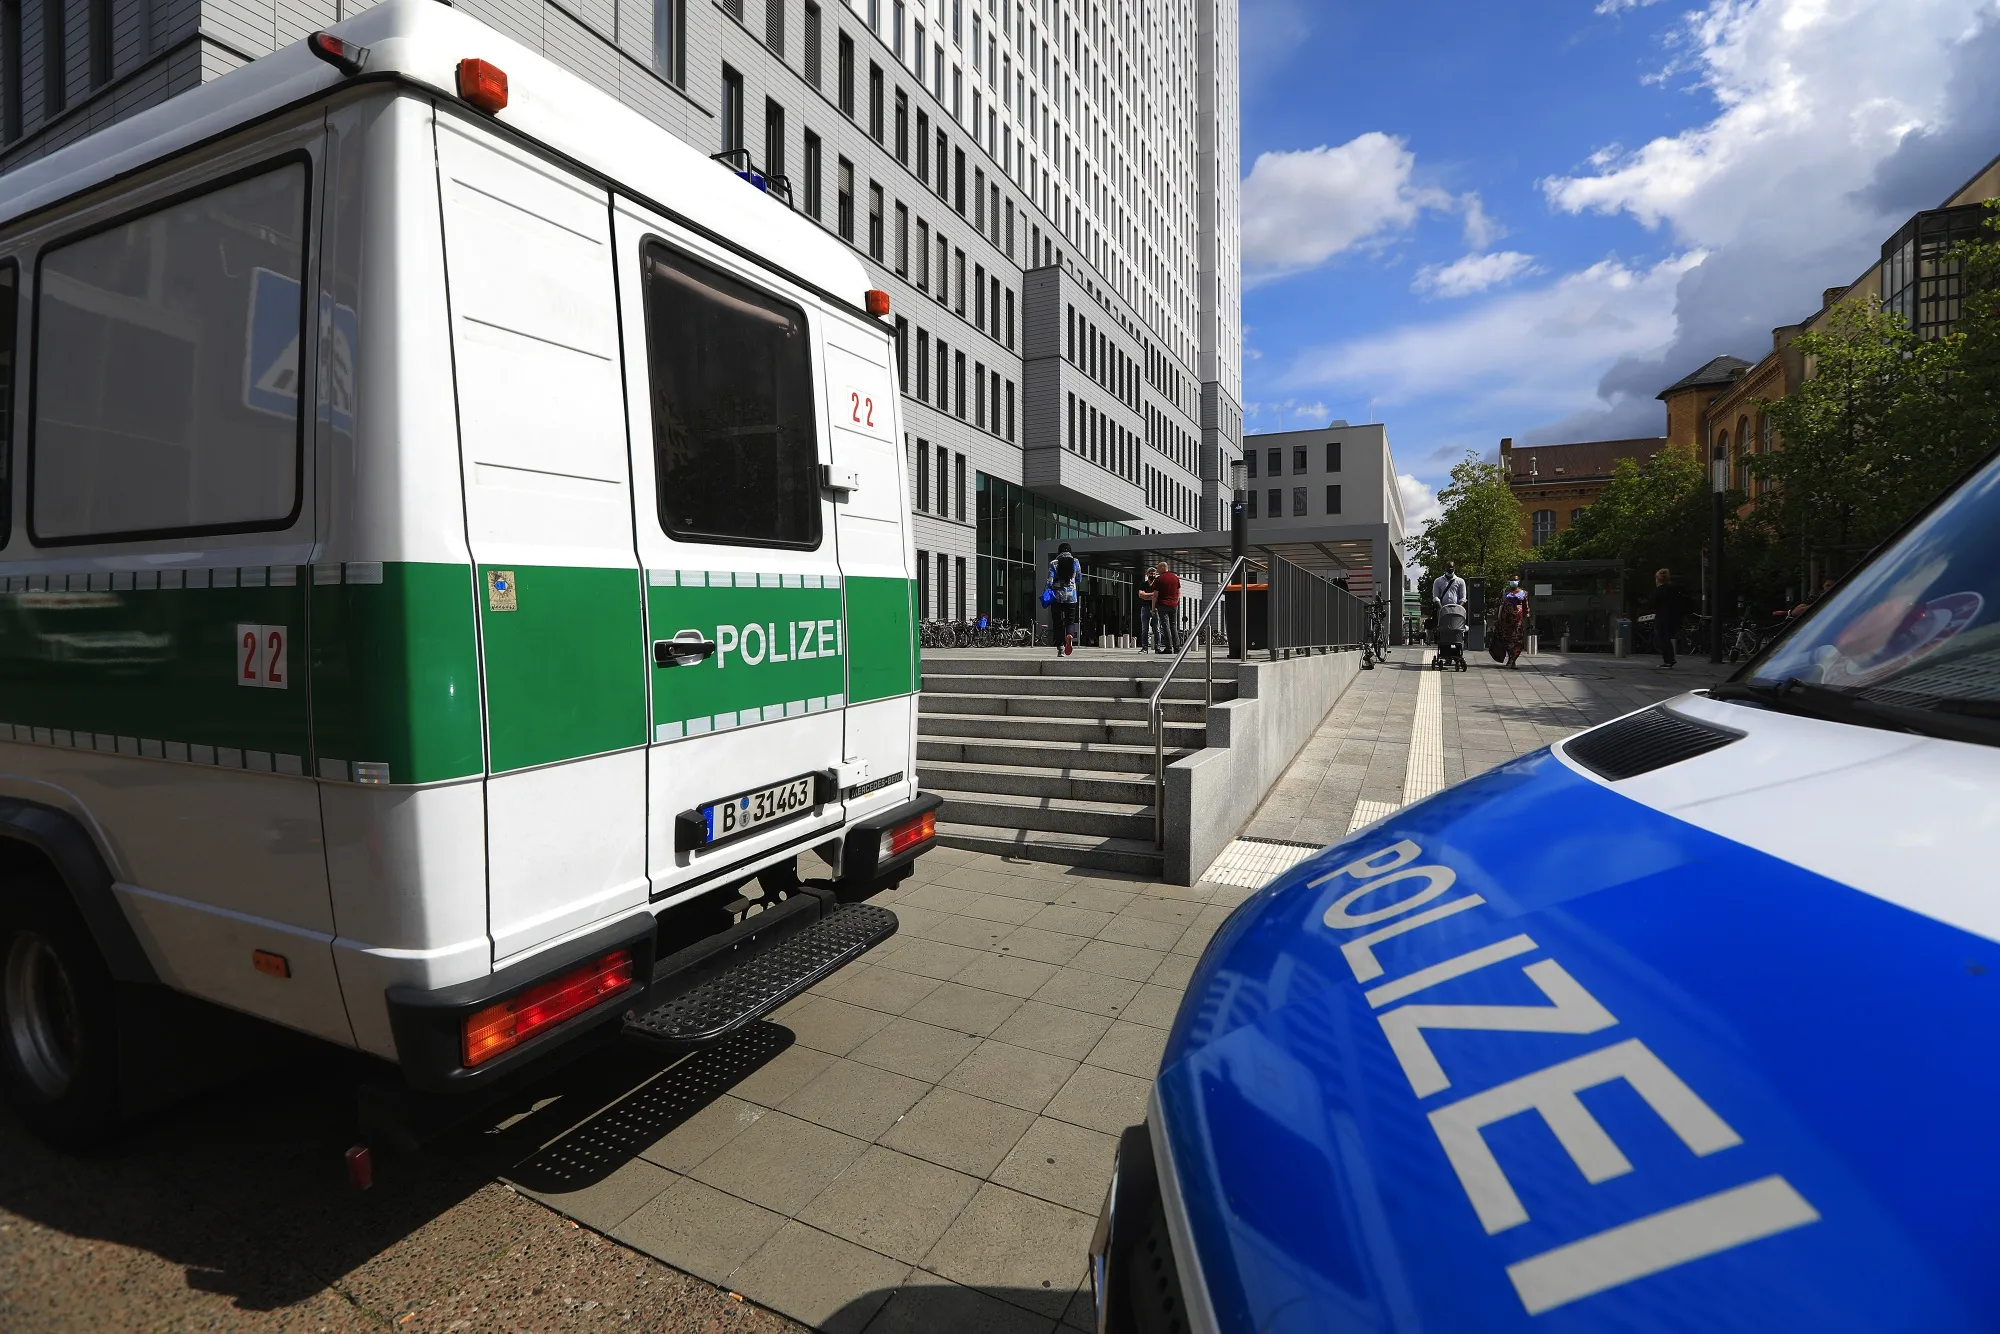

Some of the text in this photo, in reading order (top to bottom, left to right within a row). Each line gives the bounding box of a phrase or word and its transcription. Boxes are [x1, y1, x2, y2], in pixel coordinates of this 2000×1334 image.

[851, 392, 874, 428] 22
[243, 631, 282, 683] 22
[716, 619, 843, 669] POLIZEI
[723, 779, 809, 833] B 31463
[1306, 838, 1822, 1317] POLIZEI
